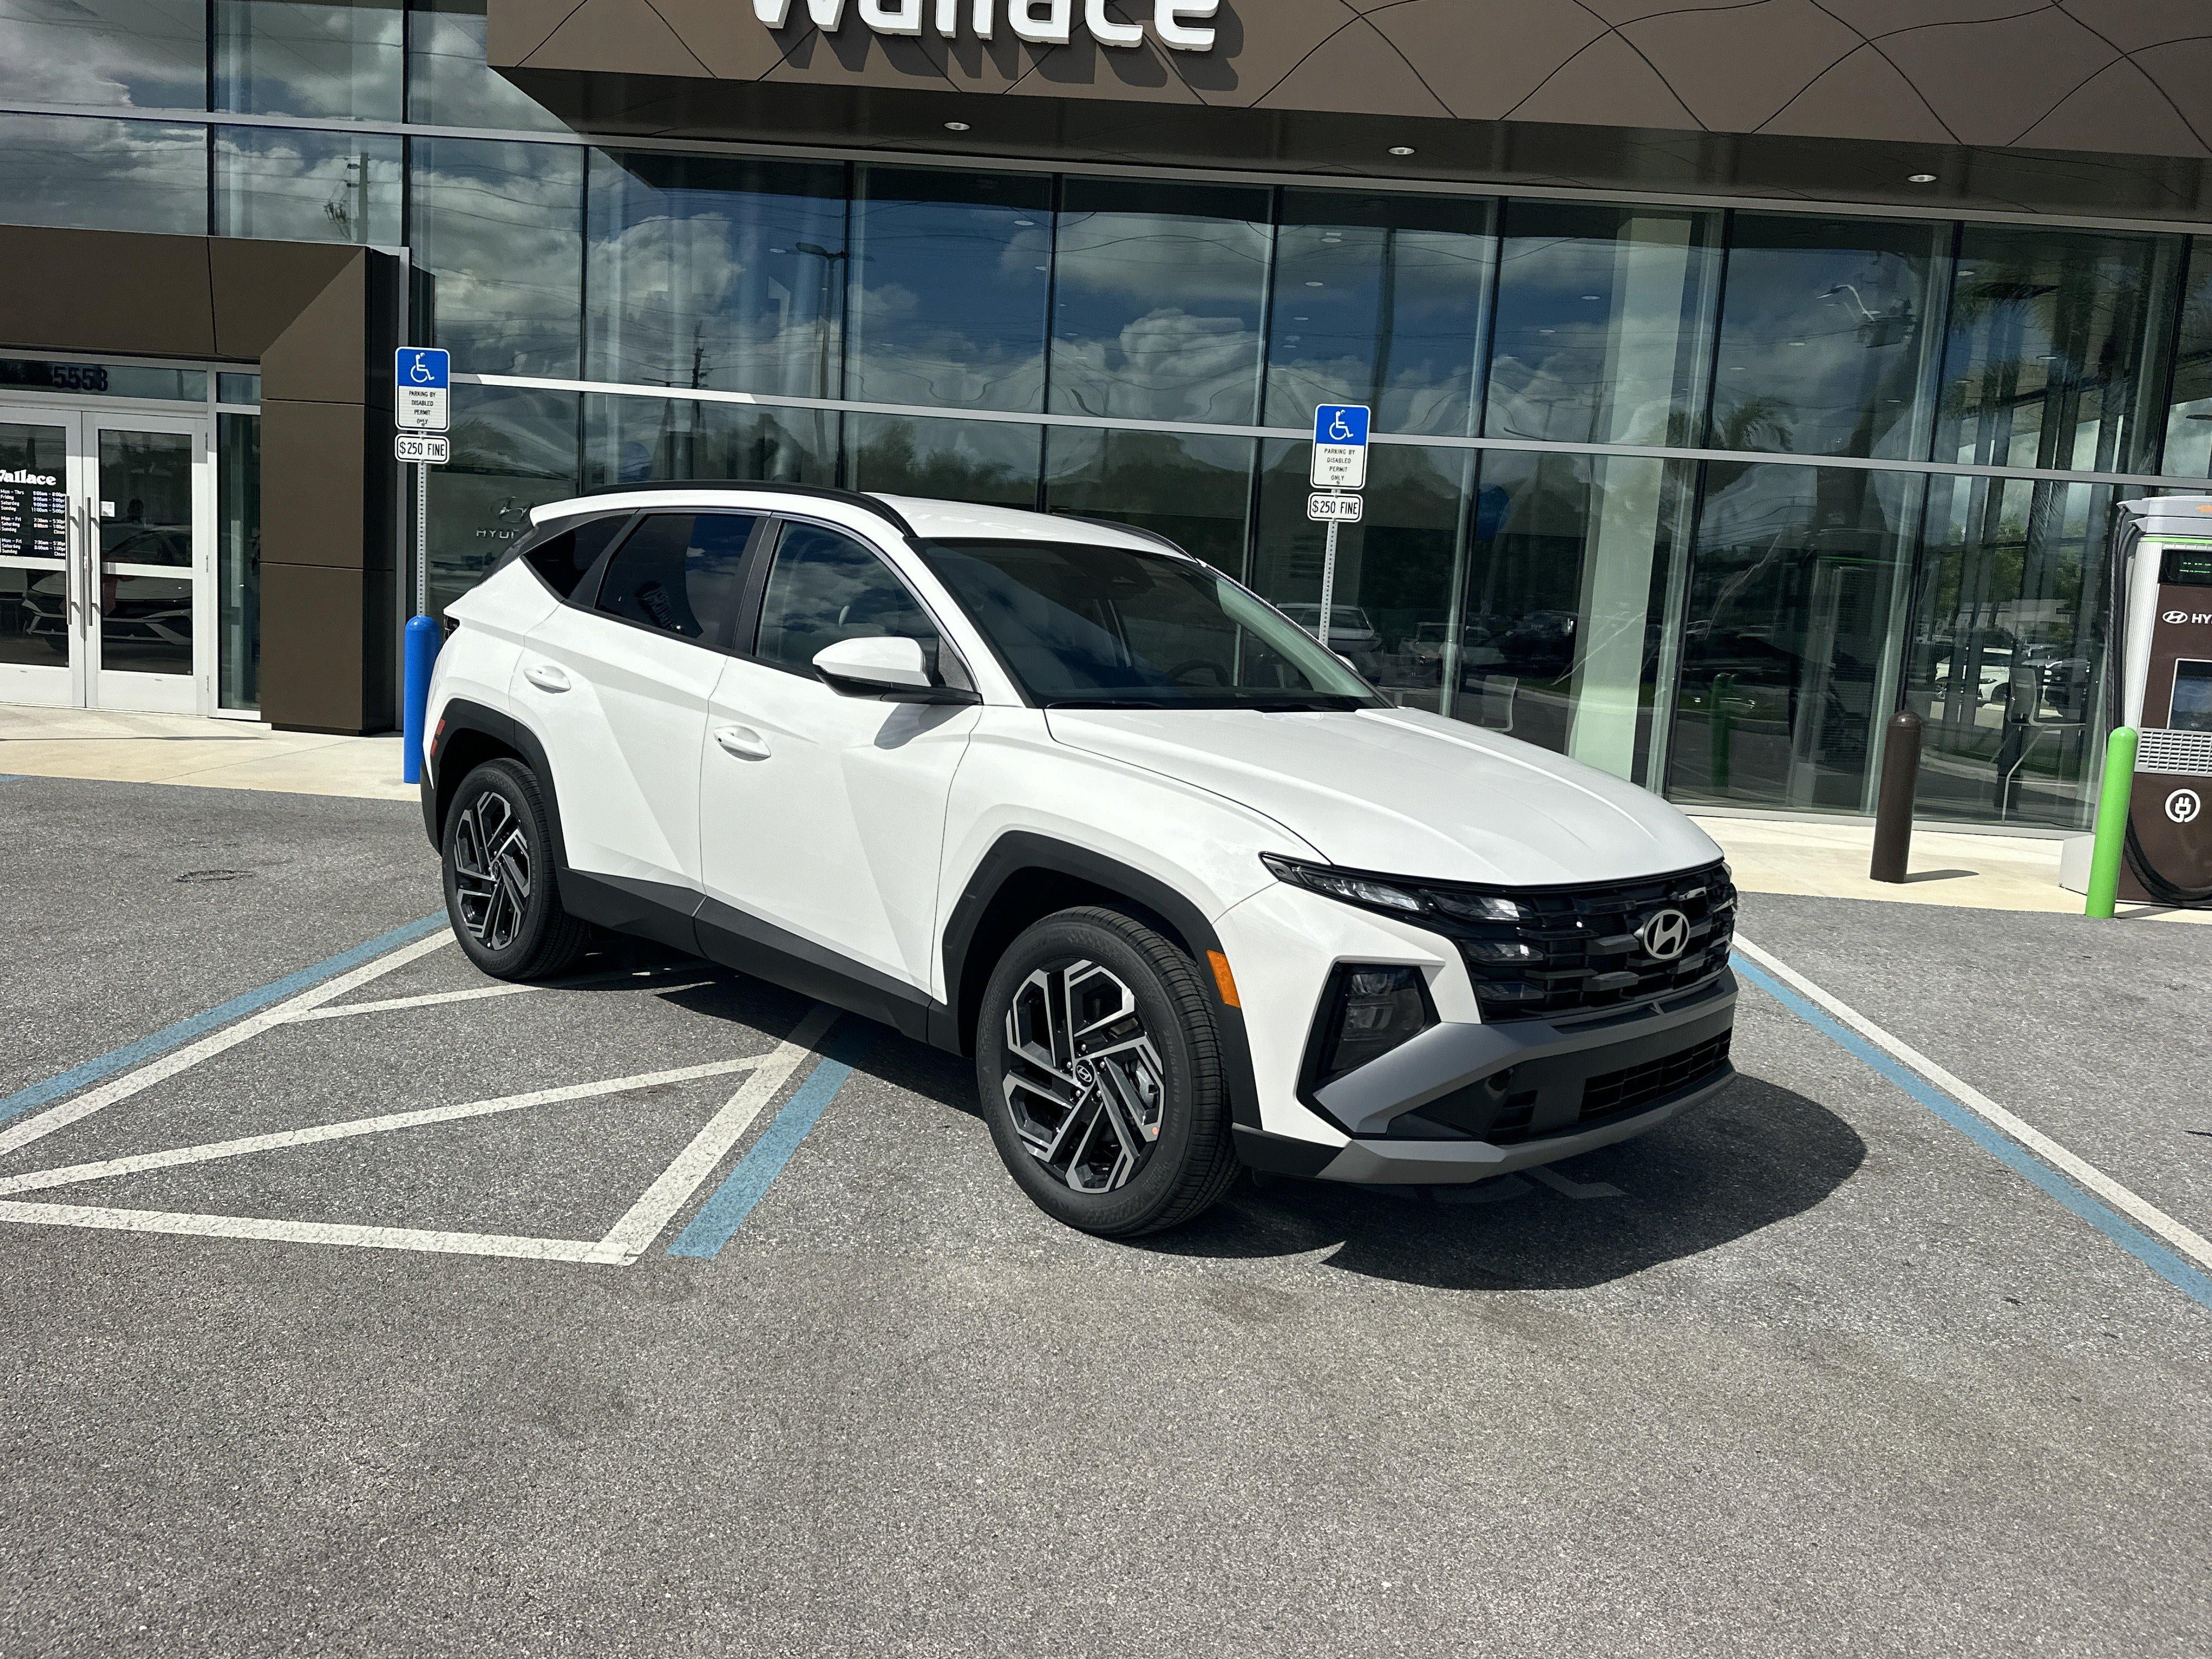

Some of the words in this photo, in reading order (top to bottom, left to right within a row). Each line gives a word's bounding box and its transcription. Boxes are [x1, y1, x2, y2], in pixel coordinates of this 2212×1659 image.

[754, 0, 1219, 51] aace
[399, 441, 423, 455] $250
[427, 443, 445, 456] FINE
[1312, 499, 1336, 514] $250
[1340, 501, 1358, 515] FINE
[2192, 613, 2212, 624] HY
